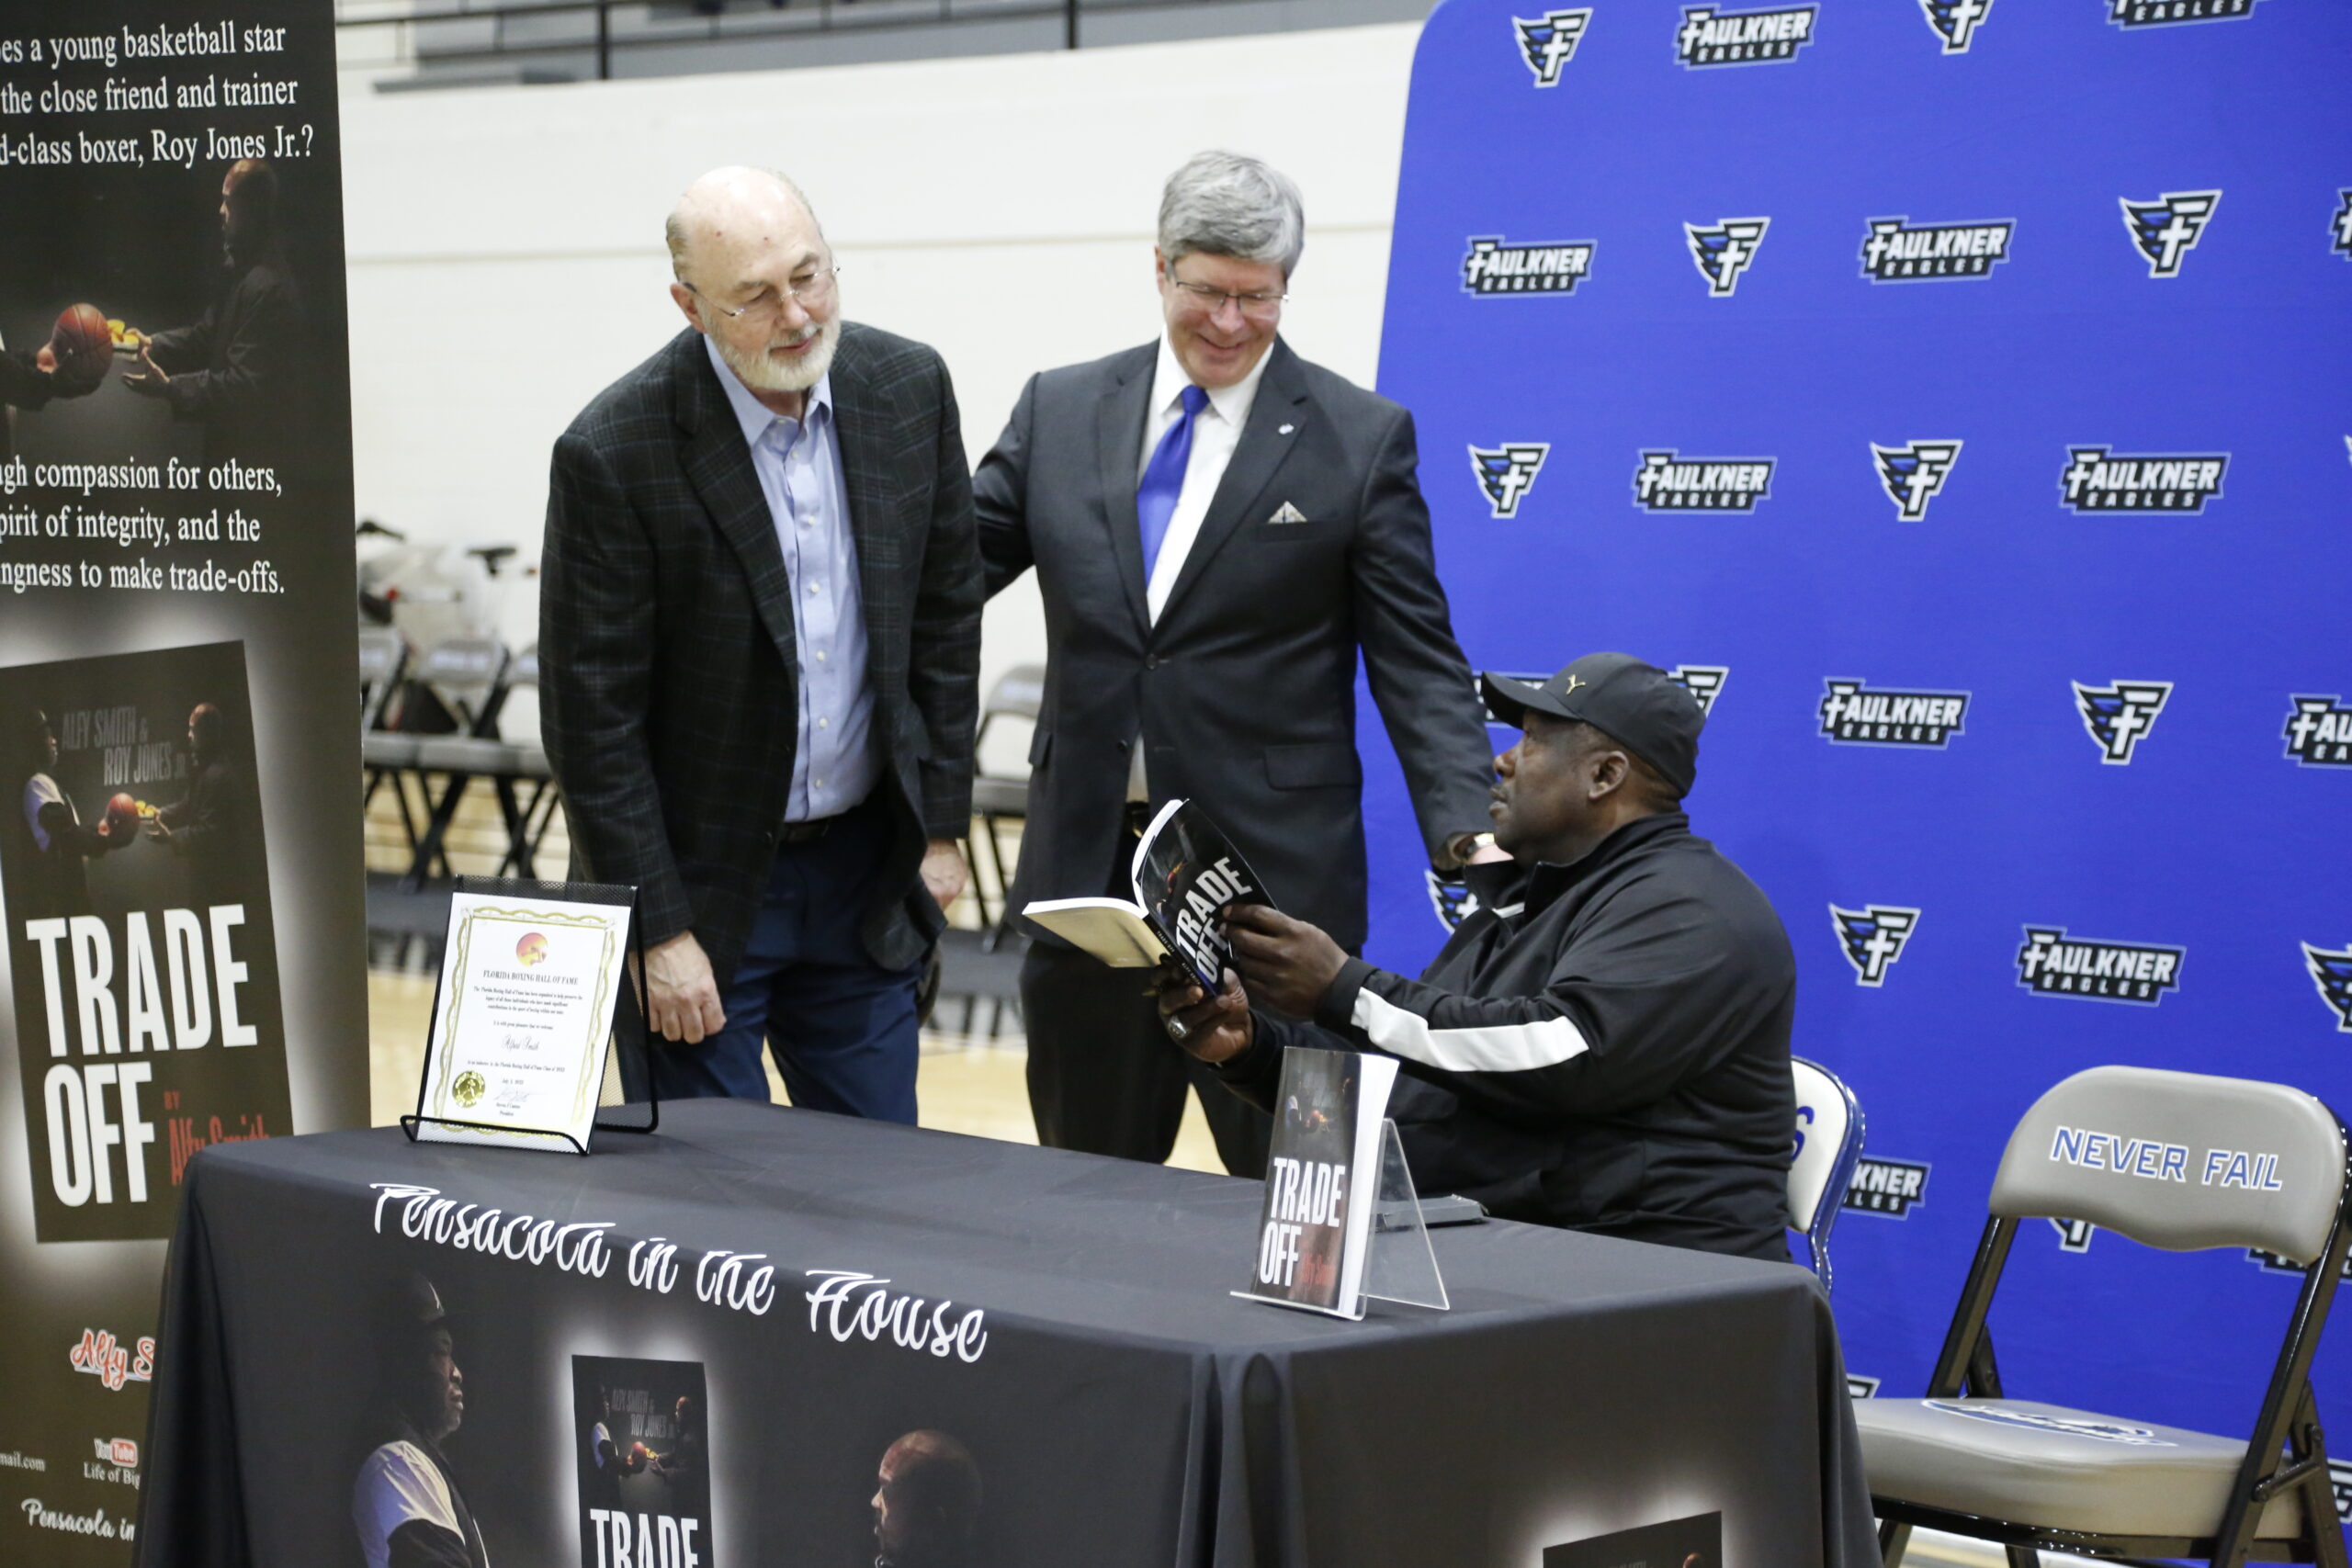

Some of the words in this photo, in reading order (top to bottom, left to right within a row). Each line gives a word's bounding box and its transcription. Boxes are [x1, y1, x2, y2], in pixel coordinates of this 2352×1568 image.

[0, 39, 23, 63] es
[30, 38, 42, 62] a
[50, 34, 117, 70] young
[122, 20, 237, 58] basketball
[244, 23, 287, 52] star
[1681, 11, 1812, 55] FAULKNER
[1697, 41, 1791, 62] EAGLES
[1, 82, 33, 114] the
[40, 80, 98, 112] close
[105, 75, 169, 111] friend
[176, 74, 217, 108] and
[222, 72, 299, 107] trainer
[78, 130, 144, 168] boxer,
[151, 129, 198, 170] Roy
[206, 127, 266, 160] Jones
[274, 124, 314, 158] Jr.?
[1467, 243, 1589, 284] FAULKNER
[1865, 224, 2007, 268] FAULKNER
[1883, 257, 1984, 276] EAGLES
[35, 457, 161, 496] compassion
[167, 457, 200, 491] for
[208, 458, 282, 497] others,
[1639, 457, 1770, 498] FAULKNER
[2067, 452, 2221, 498] FAULKNER
[2086, 491, 2194, 507] EAGLES
[46, 505, 71, 537] of
[76, 505, 171, 548] integrity,
[177, 509, 220, 541] and
[227, 509, 260, 541] the
[79, 558, 102, 588] to
[109, 558, 163, 590] make
[169, 559, 285, 593] trade-offs.
[94, 706, 137, 748] SMITH
[1824, 685, 1962, 728] FAULKNER
[1842, 723, 1940, 741] EAGLES
[104, 745, 132, 786] ROY
[134, 741, 172, 784] JONES
[1175, 856, 1253, 960] TRADE
[482, 969, 510, 979] FLORIDA
[511, 972, 534, 981] BOXING
[536, 974, 552, 983] HALL
[552, 976, 559, 984] OF
[560, 976, 578, 985] FAME
[2024, 933, 2177, 983] FAULKNER
[26, 904, 258, 1057] TRADE
[2042, 974, 2151, 998] EAGLES
[44, 1061, 155, 1208] OFF
[2049, 1125, 2189, 1182] NEVER
[2201, 1147, 2284, 1191] FAIL
[1271, 1156, 1346, 1228] TRADE
[369, 1182, 616, 1280] Pensacola
[628, 1237, 679, 1294] in
[696, 1251, 776, 1316] the
[805, 1269, 989, 1364] House
[1260, 1220, 1302, 1287] OFF
[70, 1327, 128, 1391] Alfy
[84, 1461, 106, 1482] Life
[107, 1468, 121, 1483] of
[21, 1498, 116, 1539] Pensacola
[590, 1508, 698, 1568] TRADE
